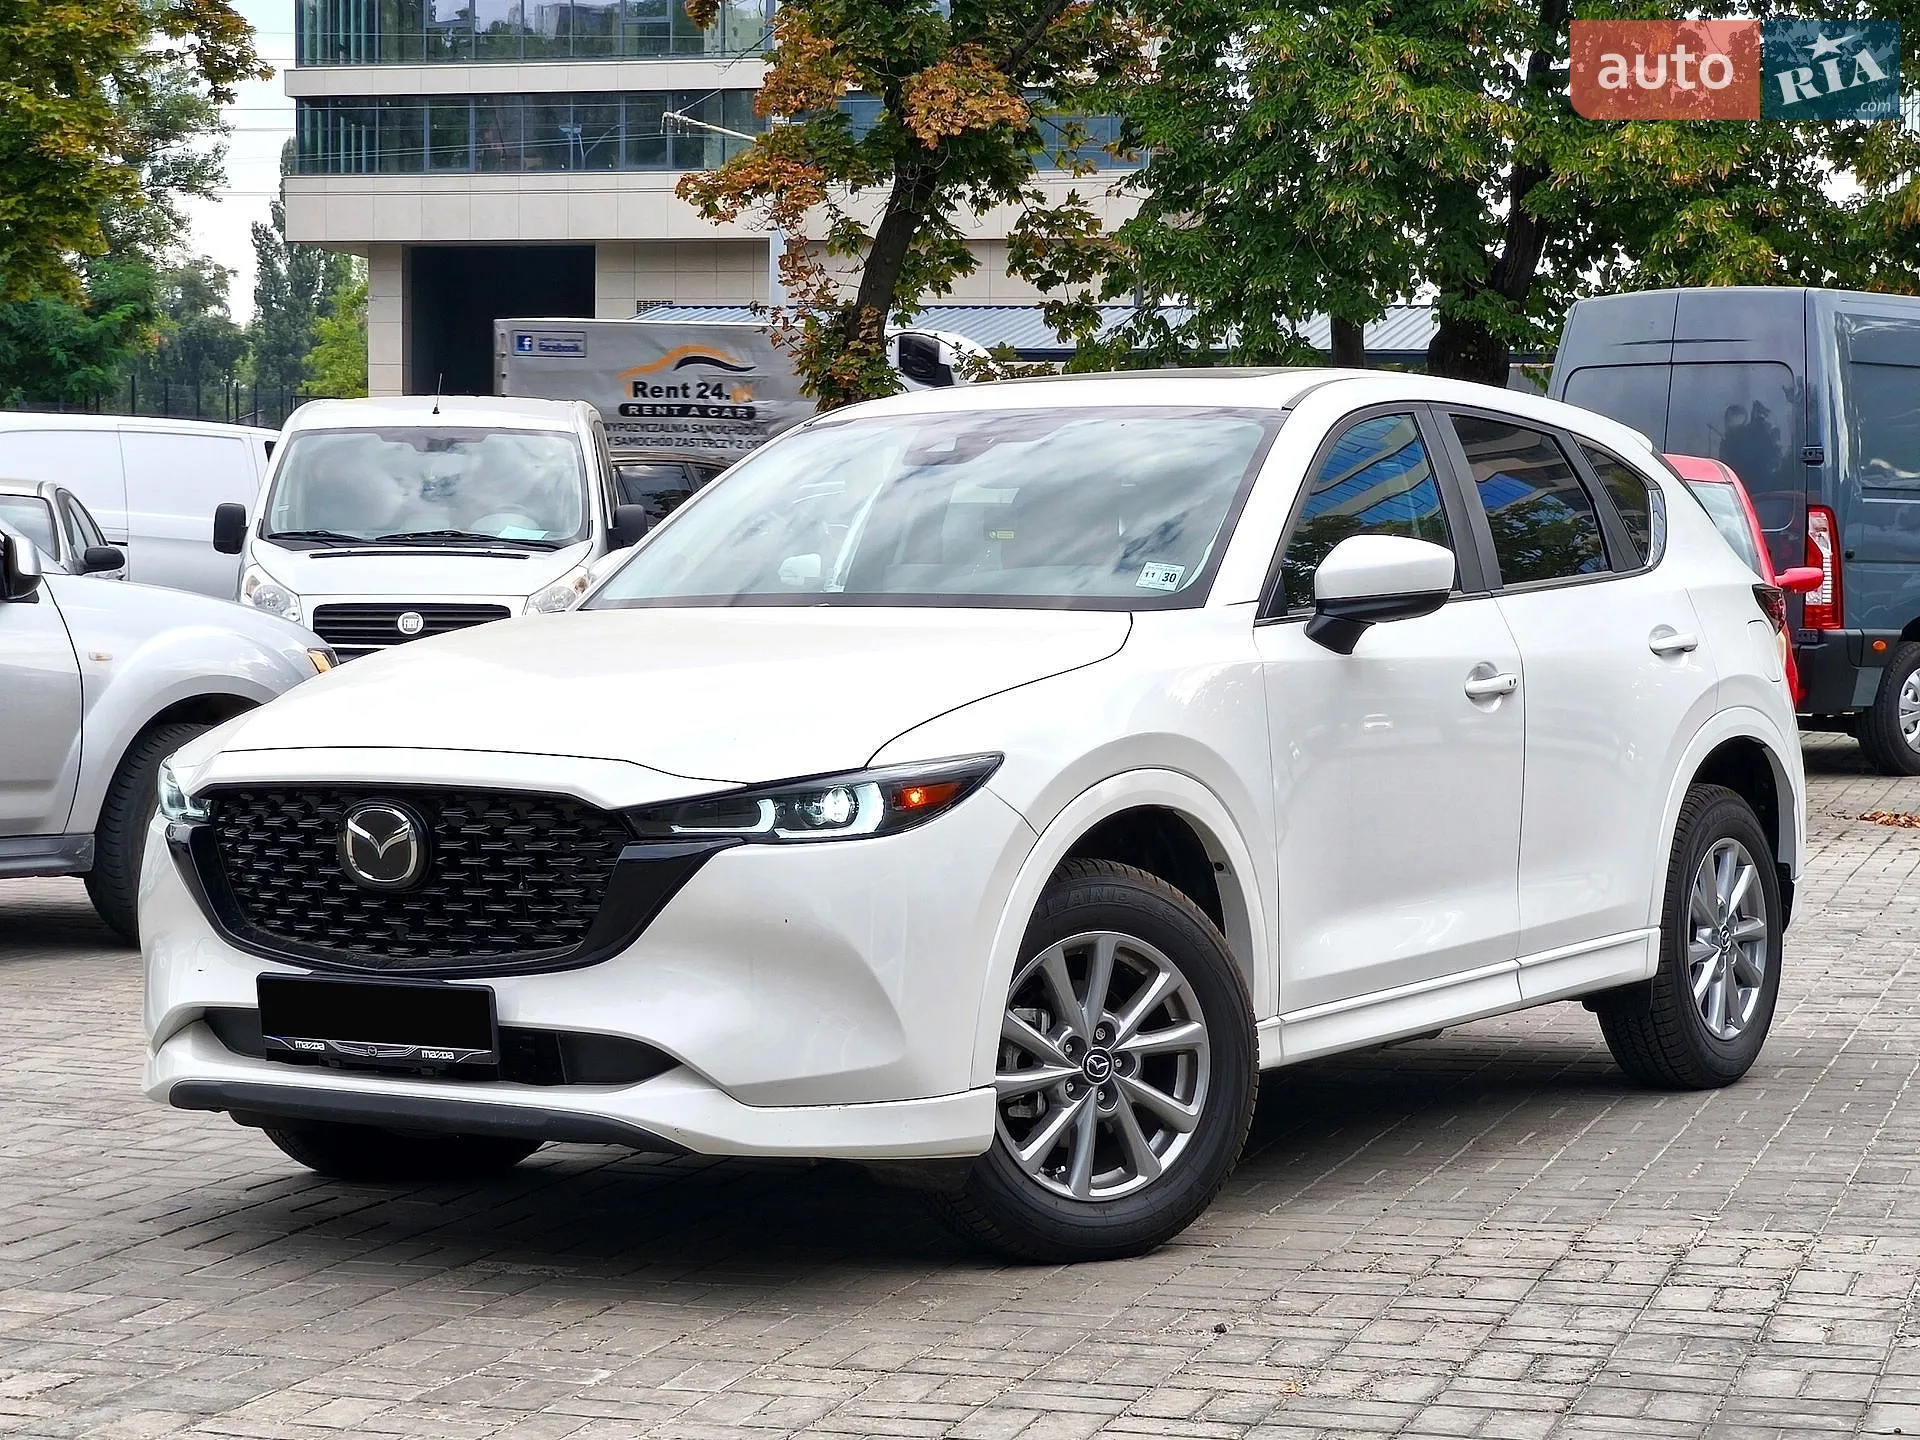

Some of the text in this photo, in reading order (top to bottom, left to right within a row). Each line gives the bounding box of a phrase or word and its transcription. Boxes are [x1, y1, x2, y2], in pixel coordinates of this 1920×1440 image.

[632, 381, 690, 399] Rent
[628, 405, 748, 418] RENT A CAR
[1162, 572, 1177, 583] 30
